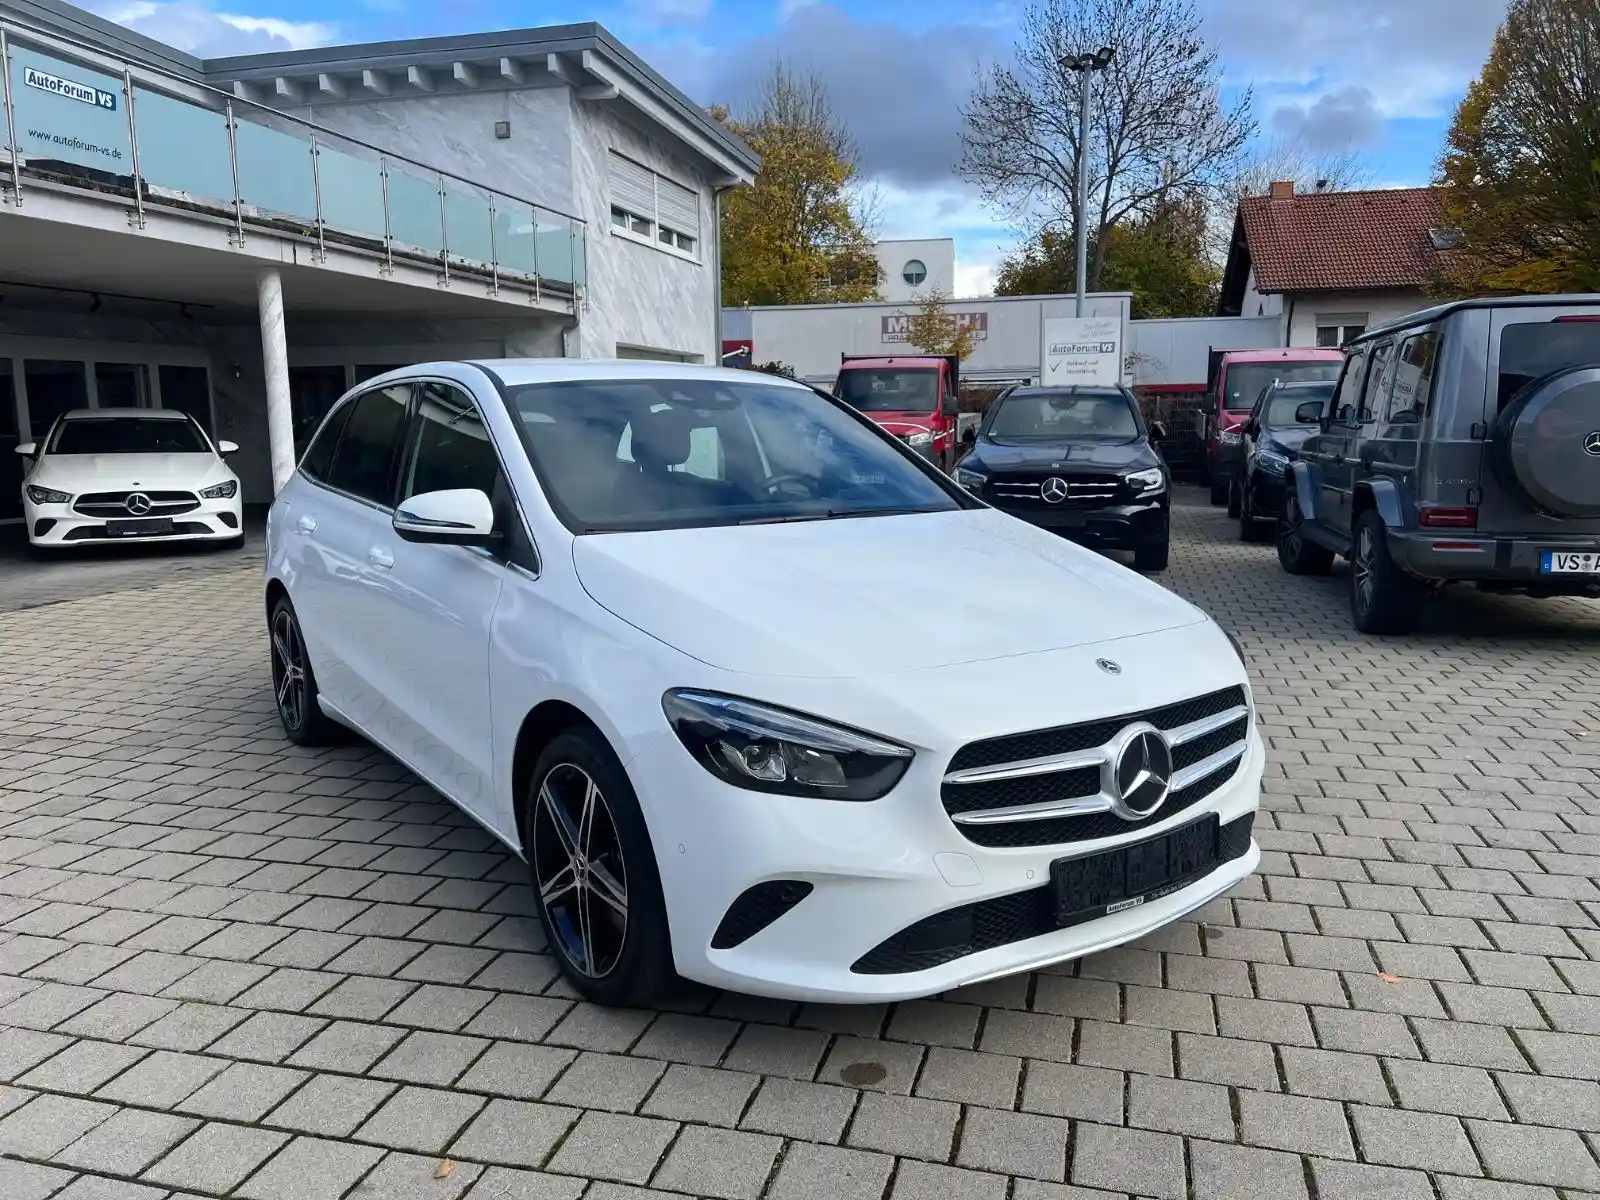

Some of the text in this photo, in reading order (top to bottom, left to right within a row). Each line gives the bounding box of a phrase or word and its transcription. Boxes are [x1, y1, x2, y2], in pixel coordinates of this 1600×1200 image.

[28, 71, 113, 108] AutoForum VS
[28, 128, 122, 159] www.autoforum-vs.de
[1052, 343, 1113, 353] AutoForum VS
